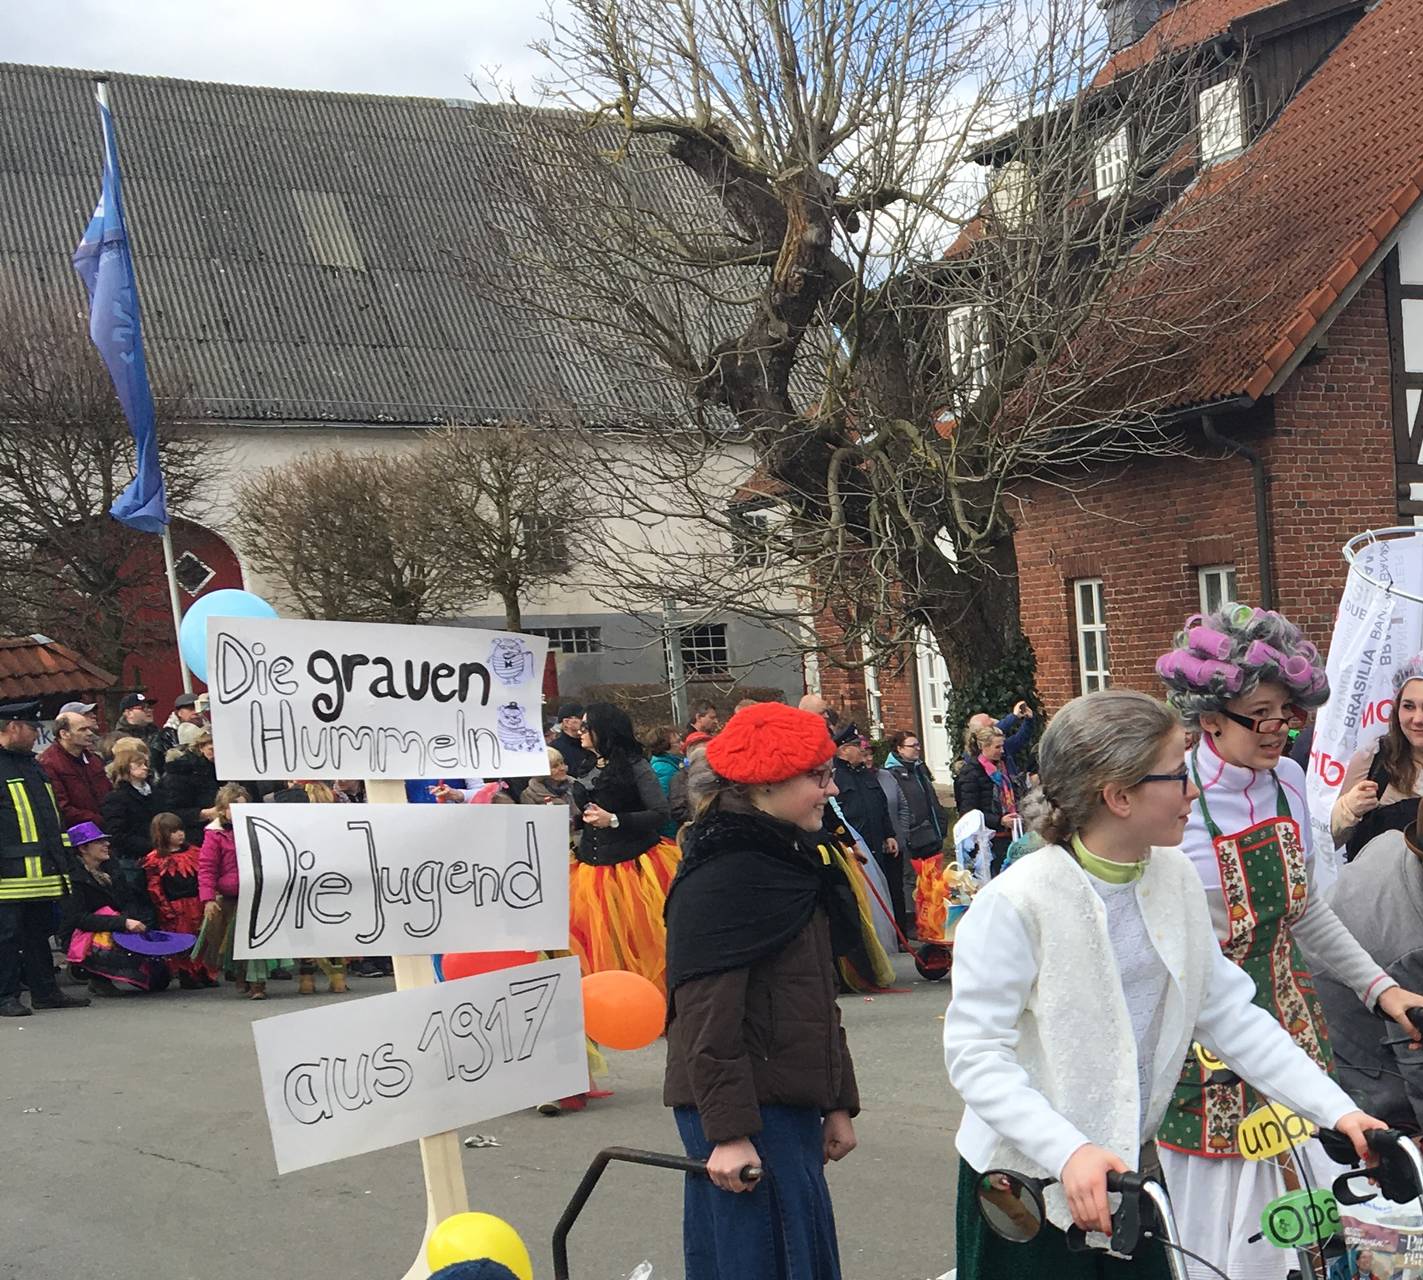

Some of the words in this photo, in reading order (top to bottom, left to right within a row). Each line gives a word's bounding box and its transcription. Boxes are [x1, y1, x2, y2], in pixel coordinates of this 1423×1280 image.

[216, 632, 298, 704] Die
[307, 649, 491, 723] grauen
[1344, 649, 1376, 728] BRASILIA
[250, 699, 501, 776] Hummeln
[246, 816, 352, 949] Die
[348, 820, 544, 944] Jugend
[283, 1043, 413, 1125] aus
[418, 973, 560, 1082] 1917
[1268, 1197, 1340, 1244] Opa
